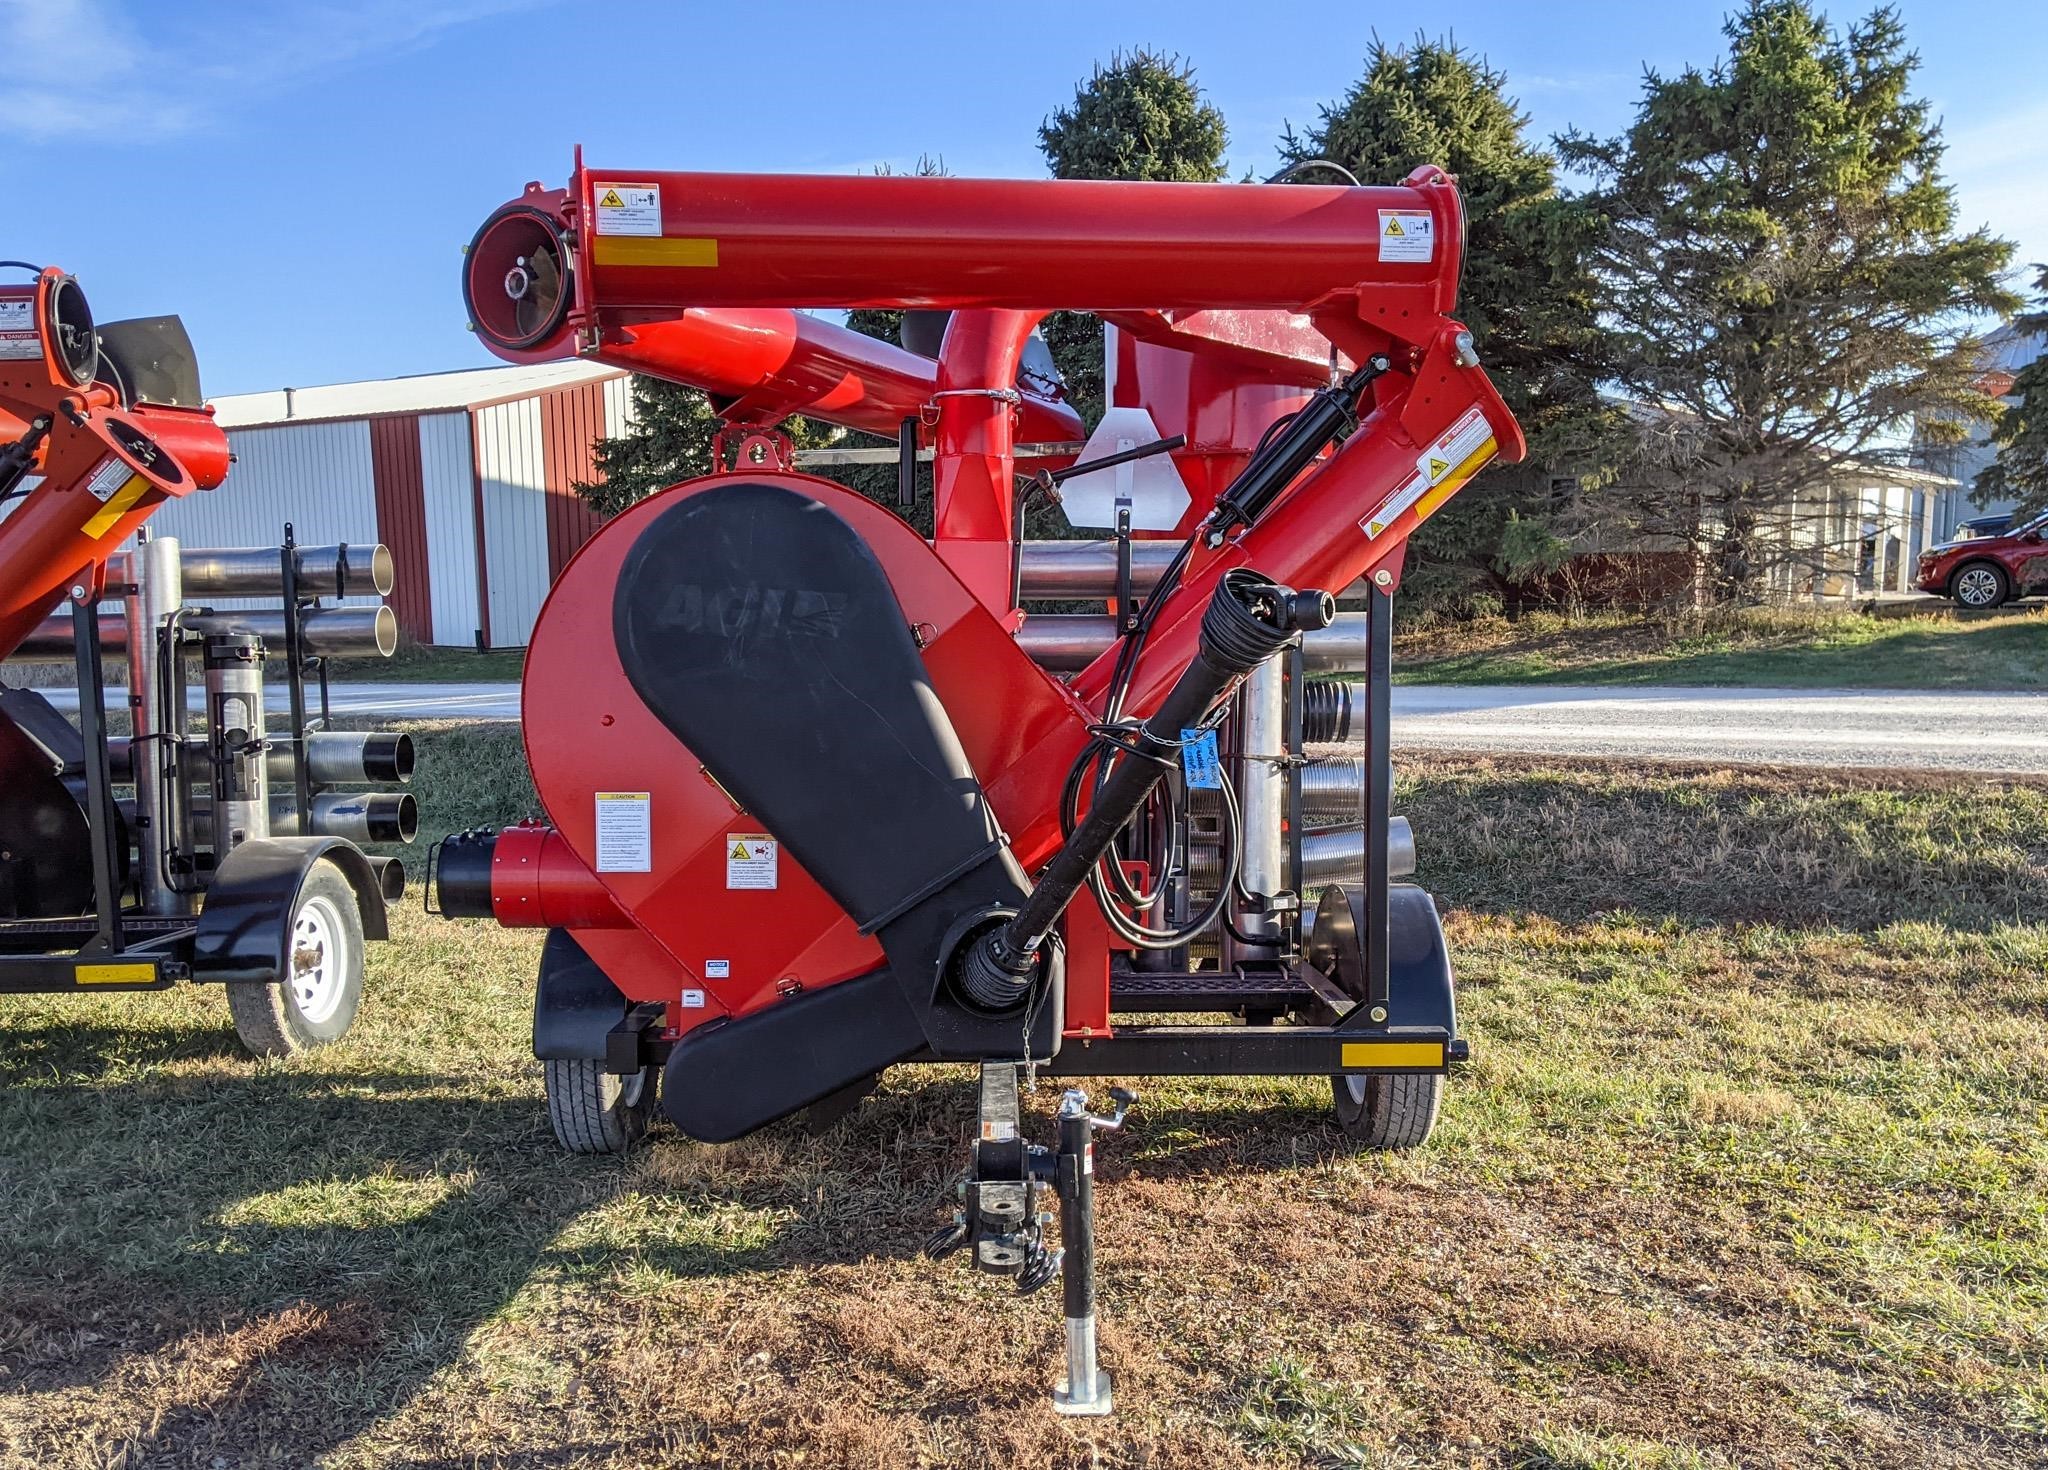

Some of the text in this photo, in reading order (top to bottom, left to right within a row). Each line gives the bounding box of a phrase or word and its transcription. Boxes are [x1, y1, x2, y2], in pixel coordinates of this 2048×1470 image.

[1451, 415, 1475, 436] DANGER
[94, 459, 111, 476] DANGER
[1385, 489, 1401, 504] DANGER
